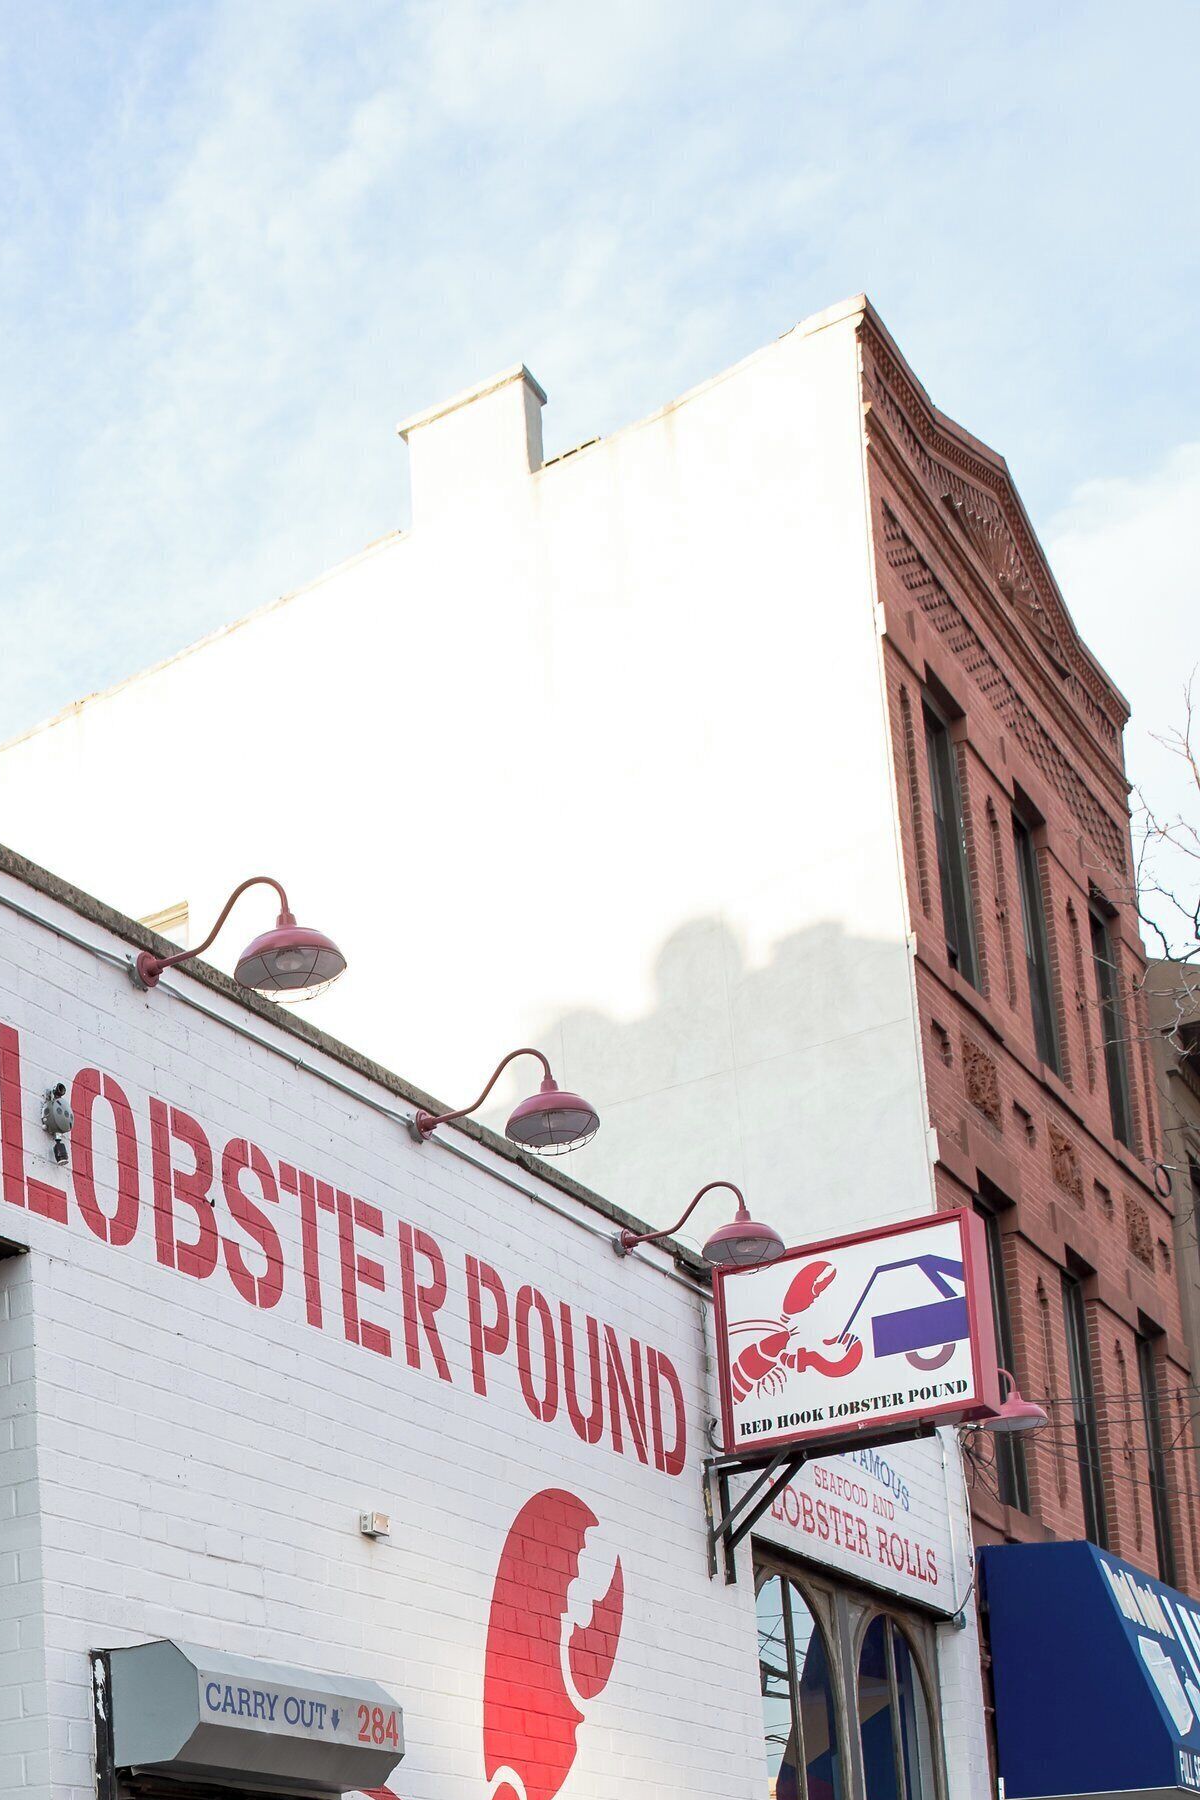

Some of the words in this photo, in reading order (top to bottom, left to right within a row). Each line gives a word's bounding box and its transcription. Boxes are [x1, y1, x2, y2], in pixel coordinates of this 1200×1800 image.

[463, 1253, 687, 1476] POUND
[740, 1418, 772, 1436] RED
[777, 1407, 824, 1429] HOOK
[828, 1392, 904, 1419] LOBSTER
[908, 1379, 968, 1403] POUND
[813, 1465, 868, 1508] SEAFOOD
[872, 1493, 895, 1521] AND
[769, 1477, 871, 1557] LOBSTER
[876, 1526, 938, 1585] ROLLS
[205, 1682, 279, 1721] CARRY
[284, 1696, 327, 1730] OUT
[357, 1705, 399, 1747] 284
